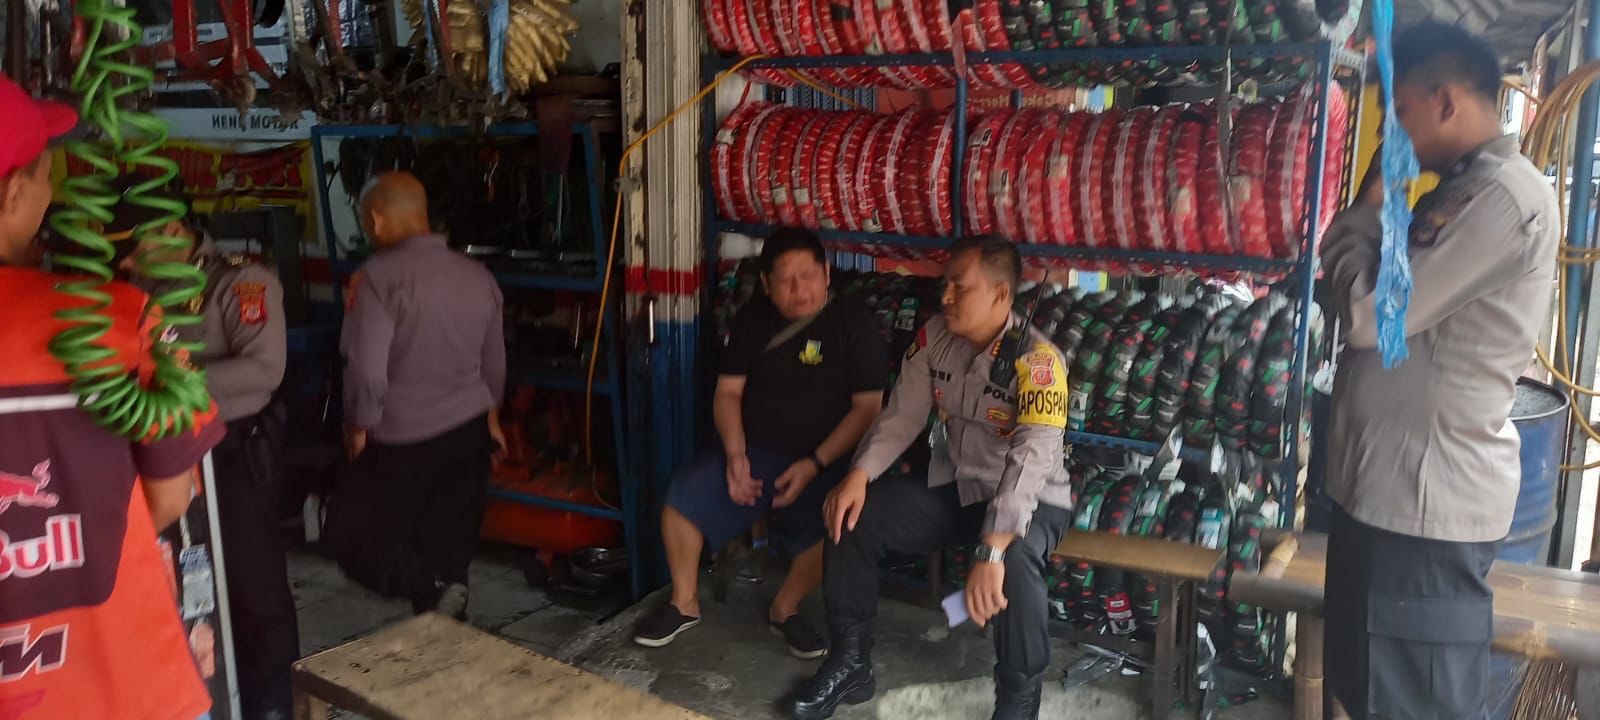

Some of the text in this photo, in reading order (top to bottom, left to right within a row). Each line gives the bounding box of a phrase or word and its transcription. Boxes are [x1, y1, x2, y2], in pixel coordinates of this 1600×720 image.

[212, 114, 299, 130] HEN MOTR
[1017, 389, 1067, 417] APOSPA
